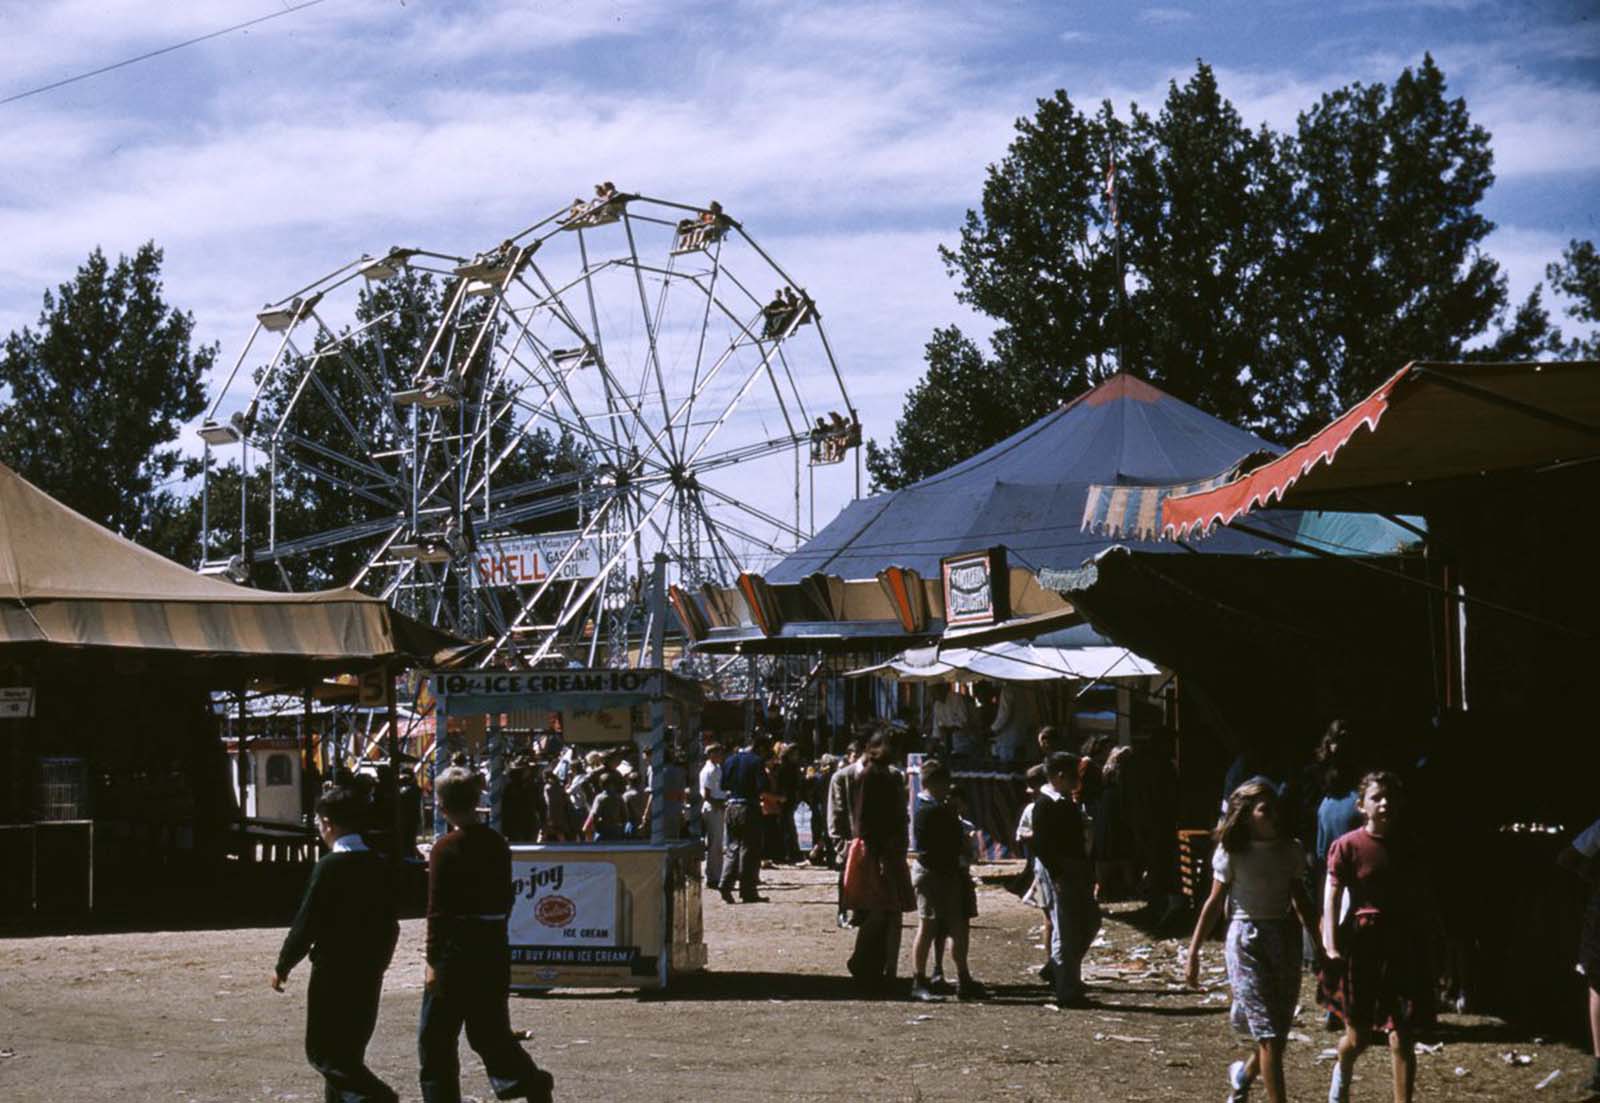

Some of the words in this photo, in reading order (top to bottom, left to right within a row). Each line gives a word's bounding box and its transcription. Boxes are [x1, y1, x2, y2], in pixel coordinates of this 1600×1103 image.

[546, 547, 590, 564] GASLINE
[478, 553, 546, 583] SHELL
[563, 564, 581, 578] OIL
[486, 675, 521, 693] ICE
[527, 674, 602, 692] CREAM
[563, 928, 576, 938] ICE
[580, 928, 609, 938] CREAM
[577, 950, 592, 960] ICE
